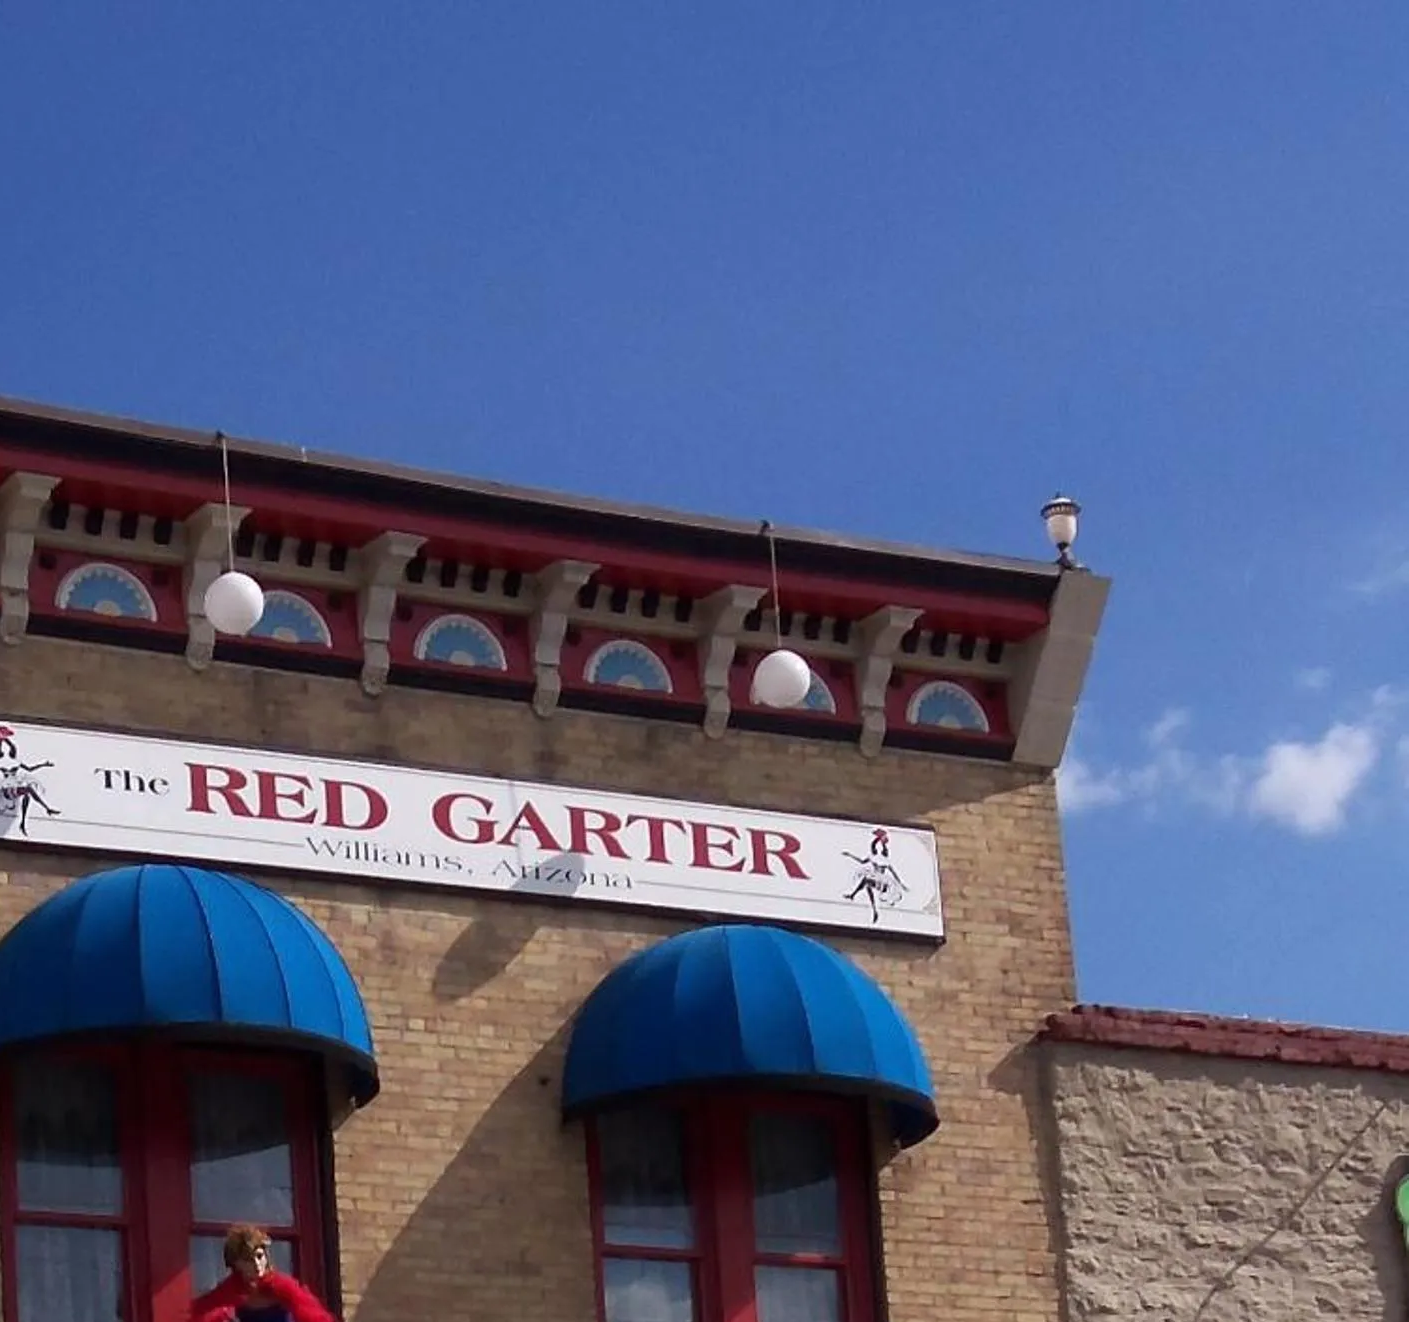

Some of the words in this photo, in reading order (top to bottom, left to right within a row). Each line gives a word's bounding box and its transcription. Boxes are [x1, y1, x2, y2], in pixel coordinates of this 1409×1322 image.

[94, 766, 171, 796] The
[184, 761, 388, 831] RED
[431, 792, 812, 880] GARTER
[304, 836, 474, 876] Williams,
[491, 859, 635, 891] Arizona
